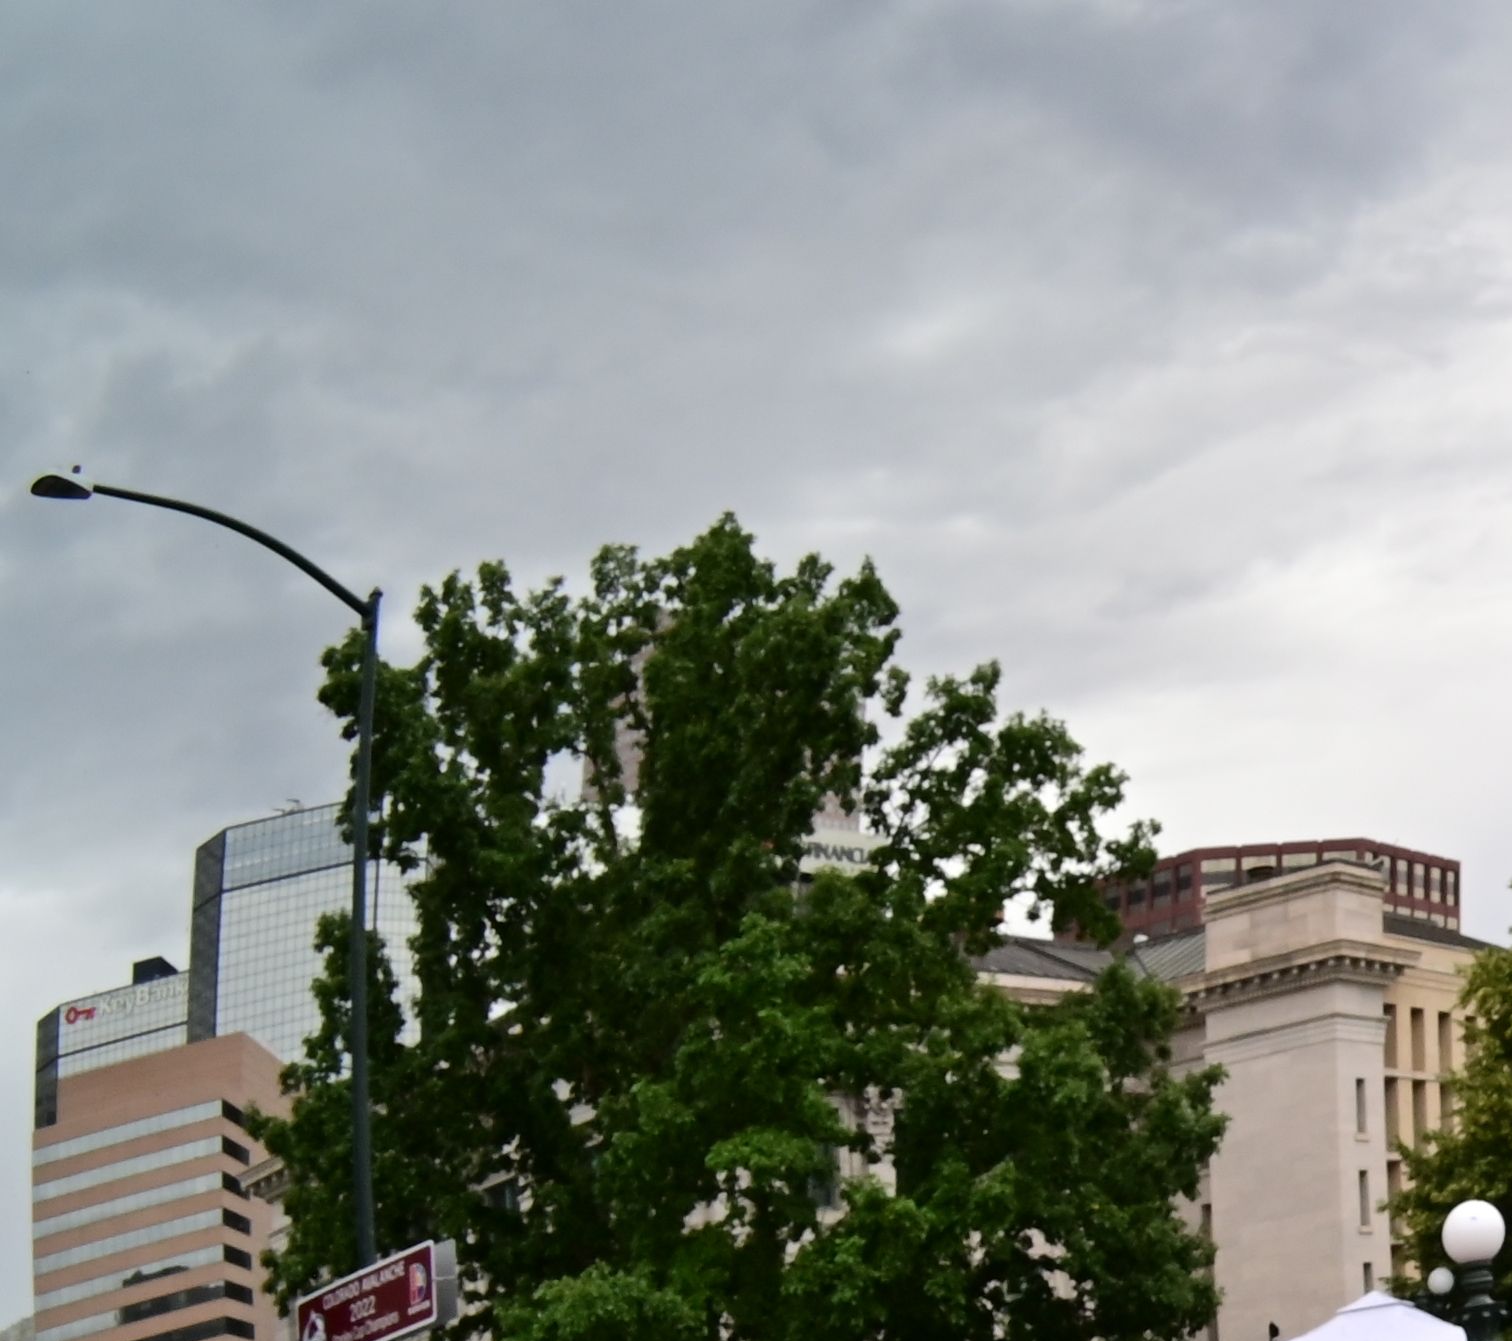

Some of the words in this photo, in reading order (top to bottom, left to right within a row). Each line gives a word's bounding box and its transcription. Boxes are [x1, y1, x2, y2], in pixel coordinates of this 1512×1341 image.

[322, 1281, 361, 1312] COLORADO
[361, 1261, 406, 1293] AVALANCHE
[350, 1295, 377, 1323] 2022
